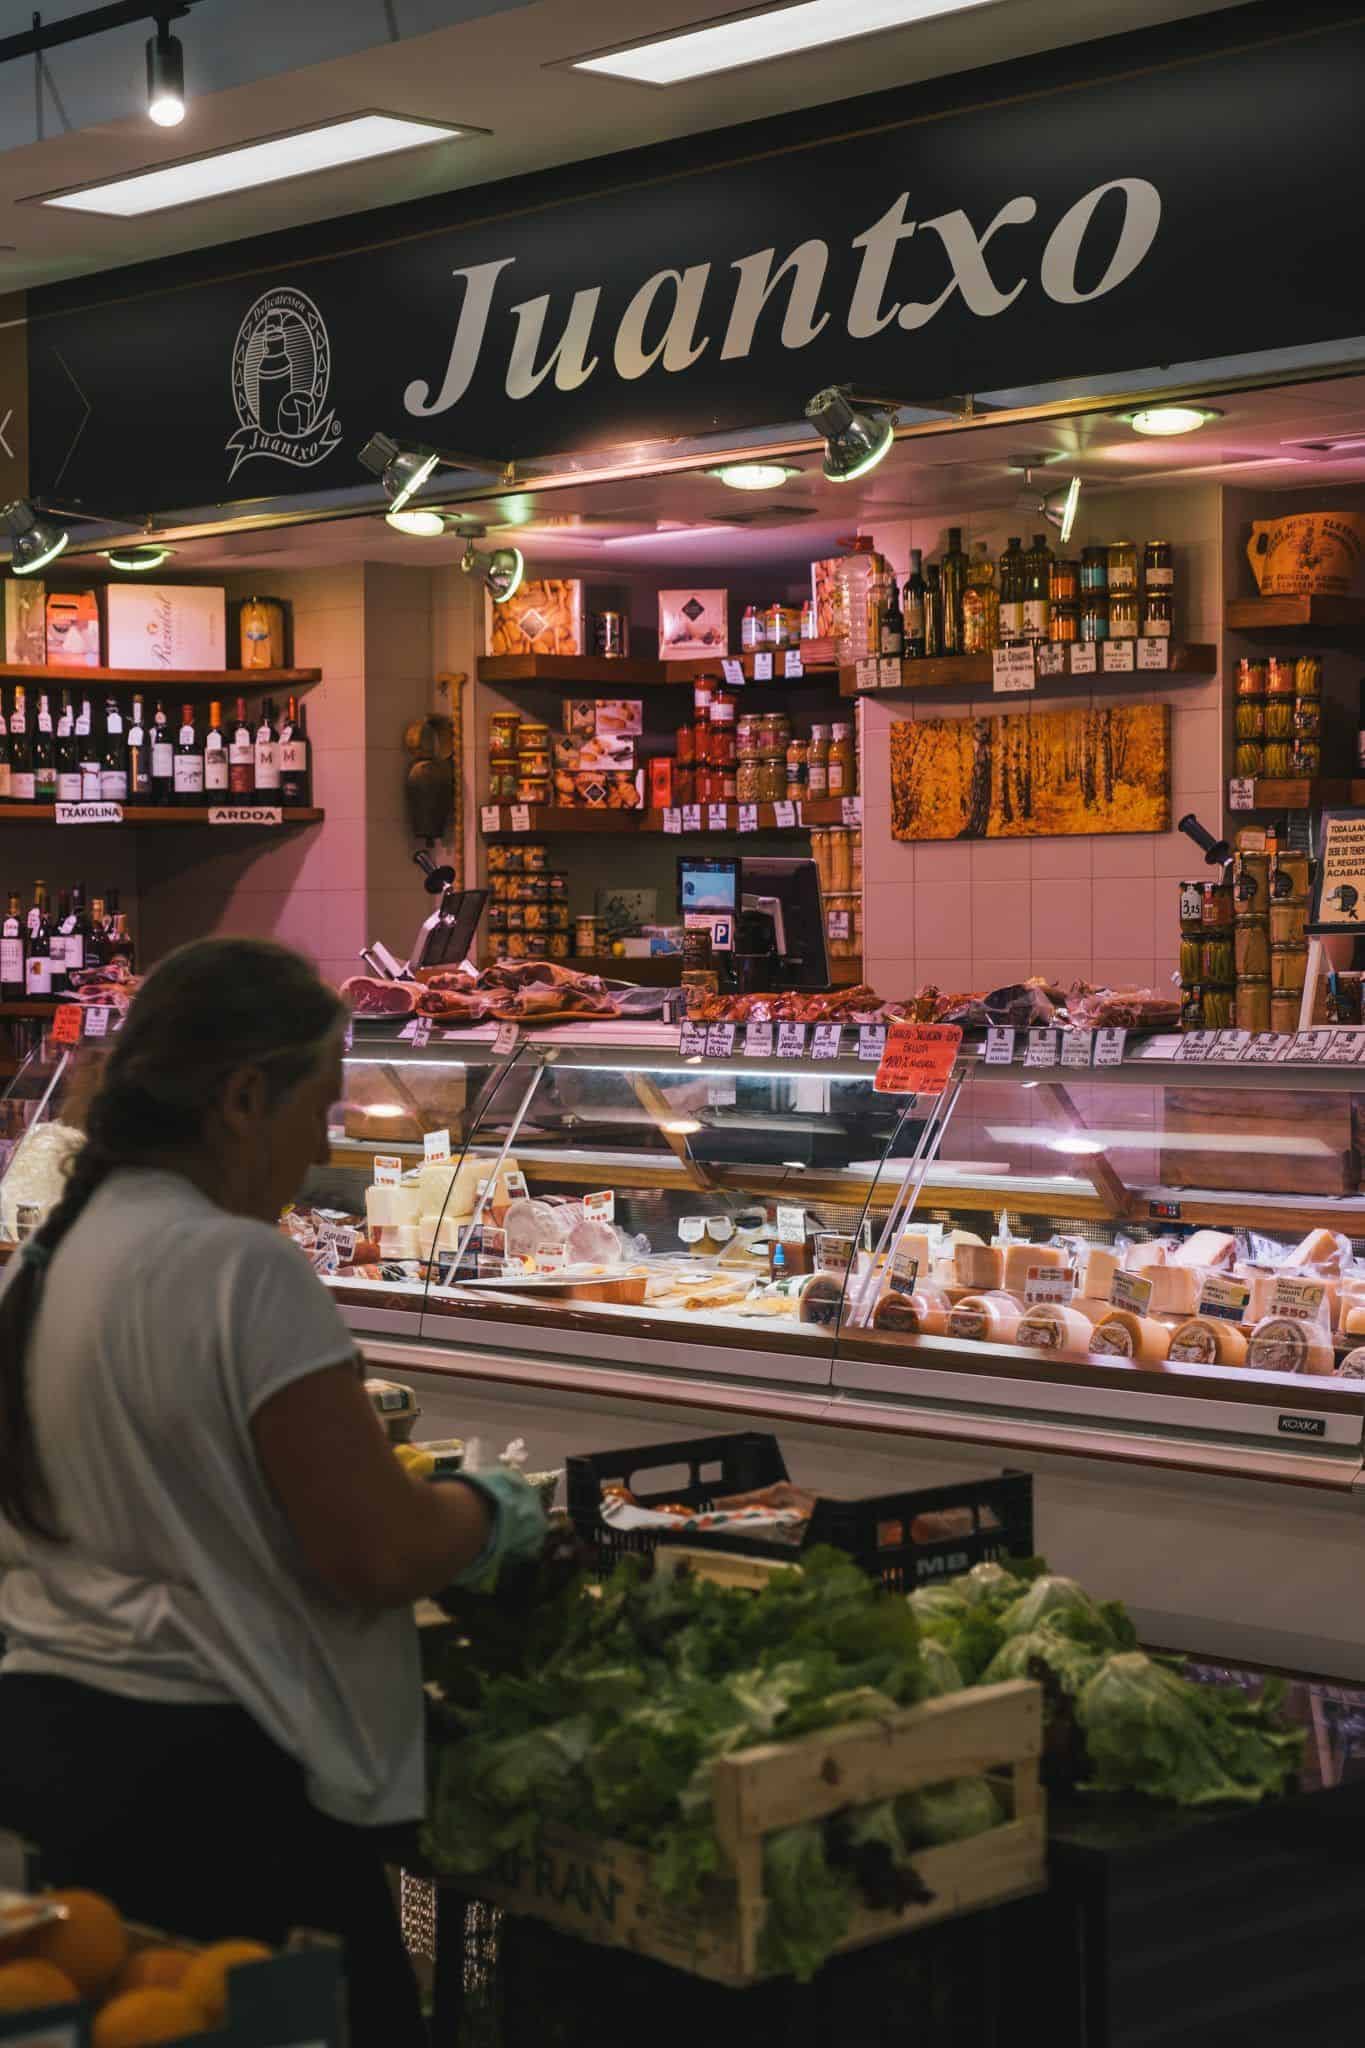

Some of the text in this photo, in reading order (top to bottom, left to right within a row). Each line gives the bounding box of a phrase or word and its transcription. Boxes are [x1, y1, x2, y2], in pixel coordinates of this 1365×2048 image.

[403, 177, 1162, 417] Juantxo
[253, 295, 306, 322] Delicatessen
[249, 431, 318, 460] Juantxo
[261, 752, 273, 764] M
[284, 750, 295, 761] M
[61, 807, 119, 817] TXAKOLINA
[216, 811, 275, 820] ARDOA
[1331, 825, 1347, 833] TODA
[1328, 848, 1341, 856] DEBE
[1342, 848, 1348, 856] DE
[717, 925, 727, 942] P
[1271, 1305, 1309, 1319] 1250
[1282, 1419, 1319, 1432] KOXKA
